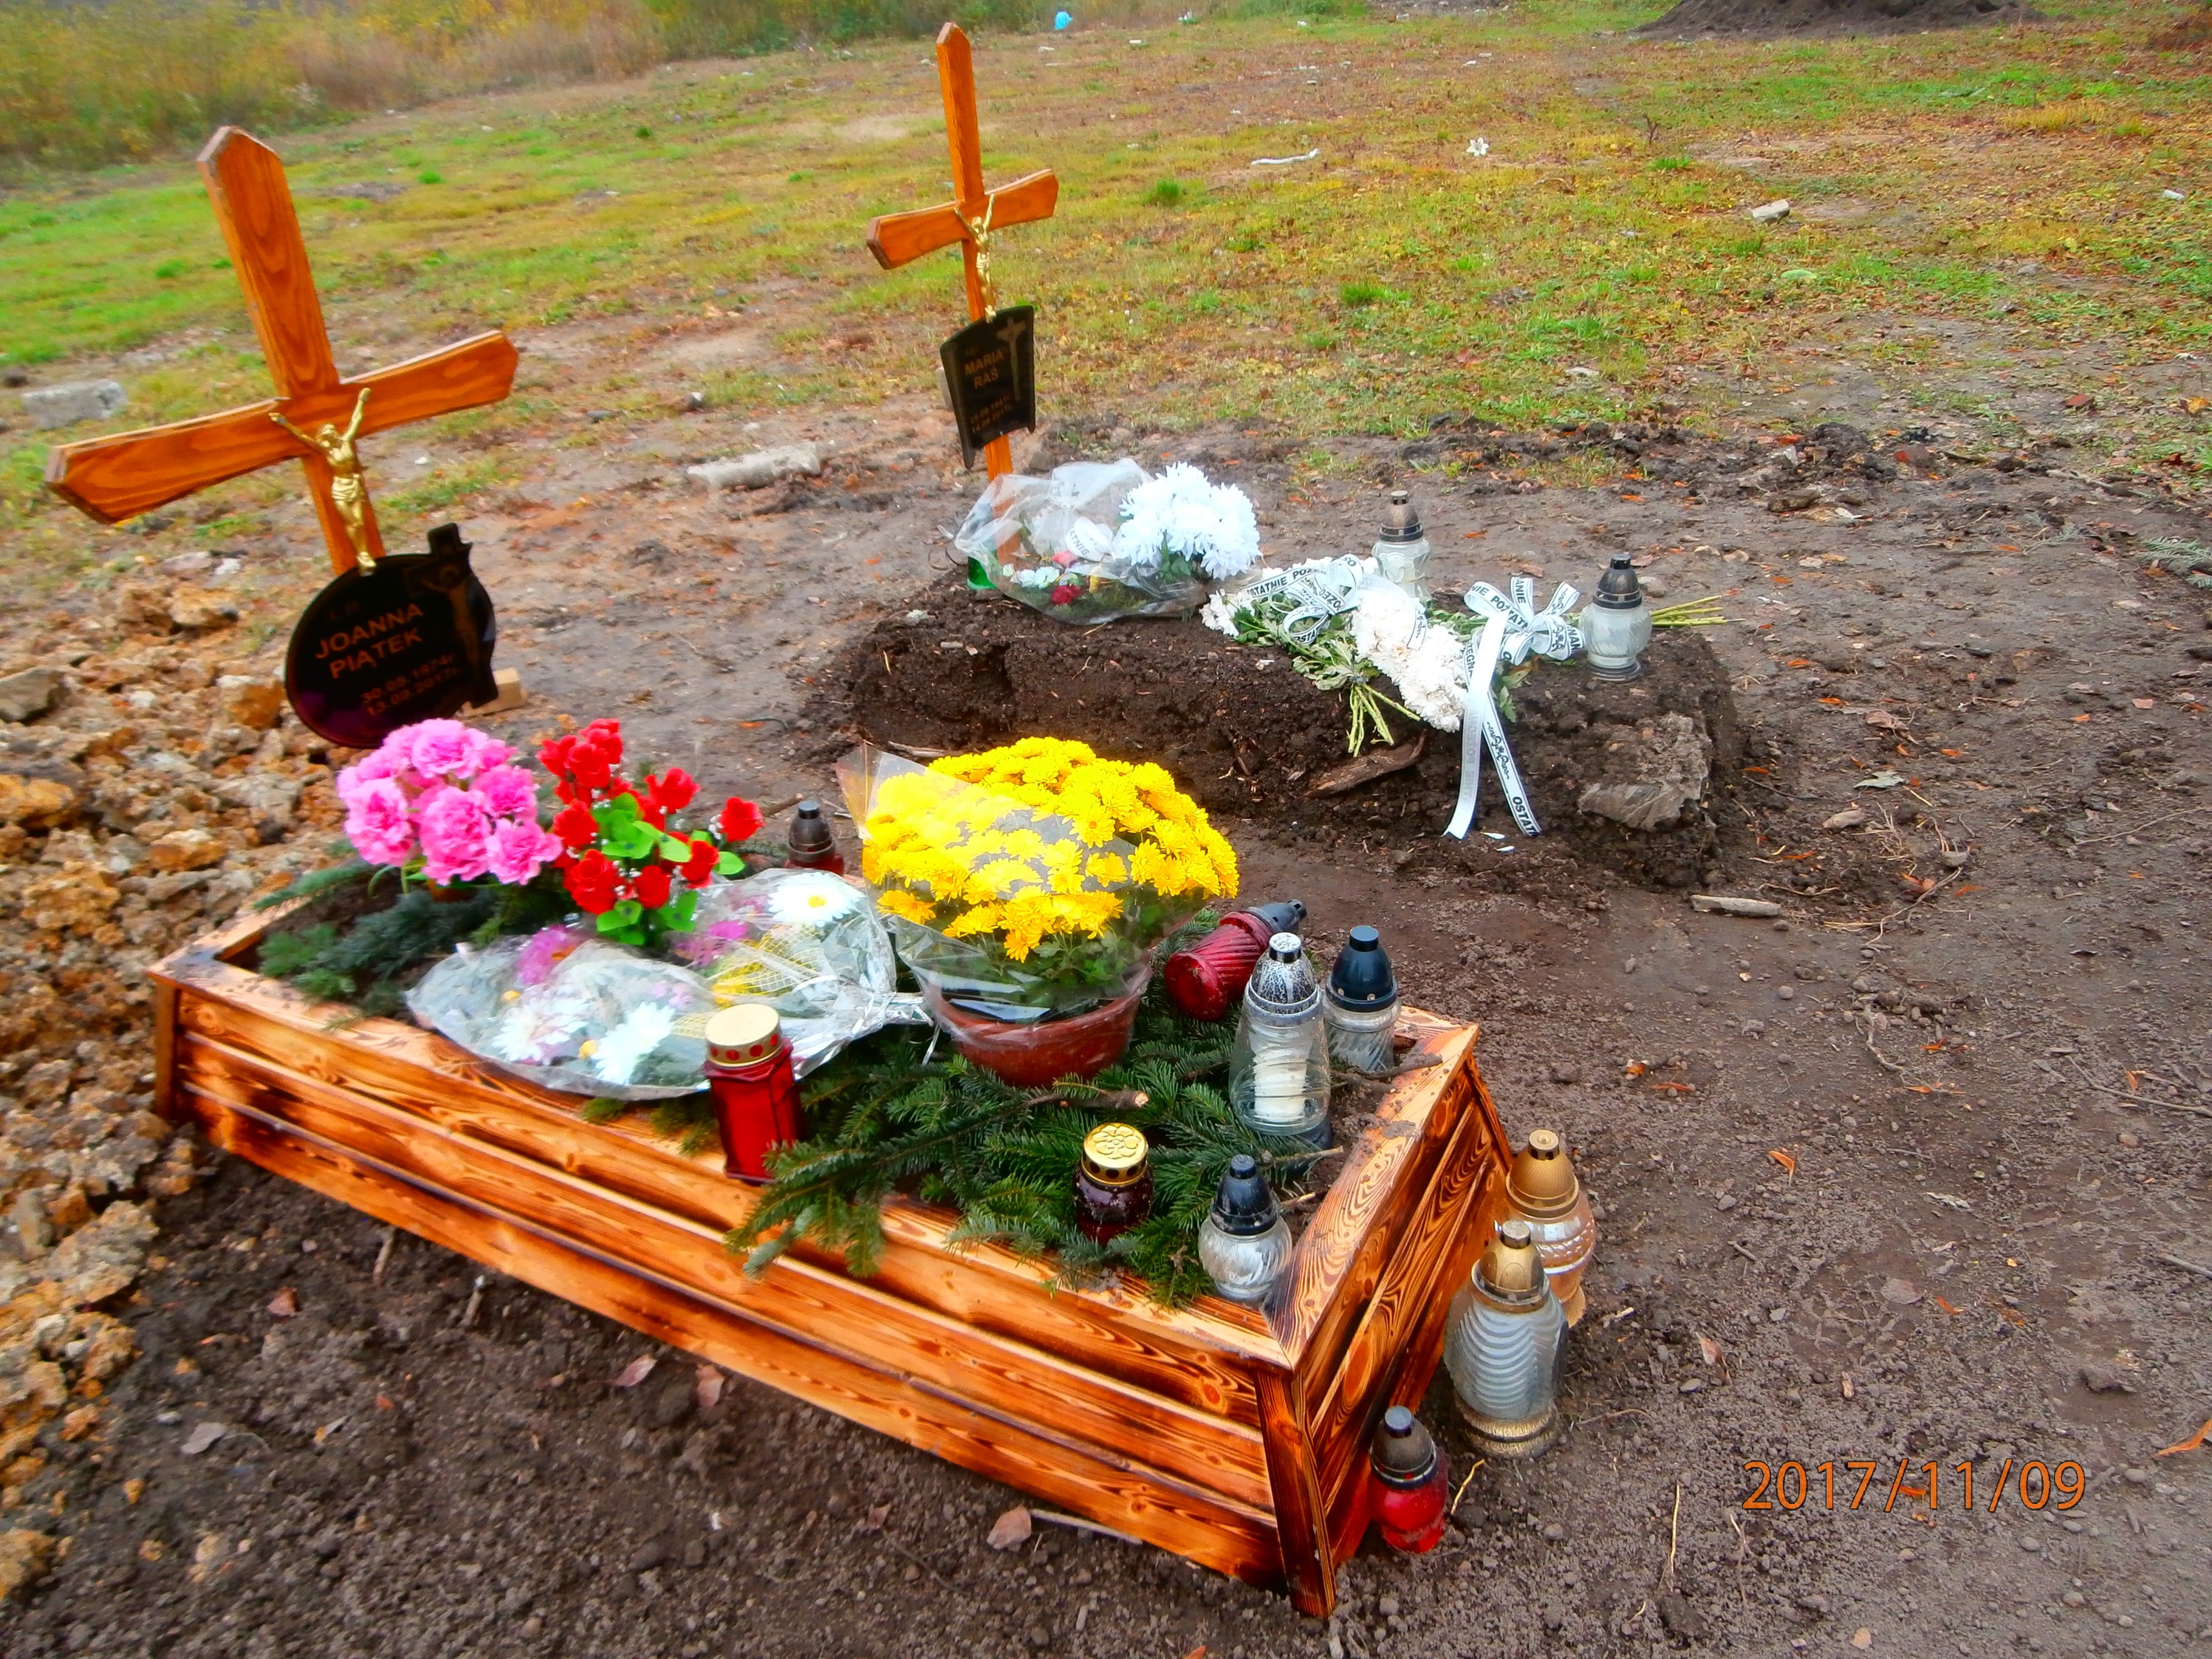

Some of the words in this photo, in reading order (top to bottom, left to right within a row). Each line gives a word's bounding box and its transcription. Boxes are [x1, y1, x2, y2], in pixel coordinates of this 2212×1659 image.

[965, 349, 1004, 375] MARIA
[315, 603, 424, 658] JOANNA
[329, 627, 423, 678] PIĄTEK
